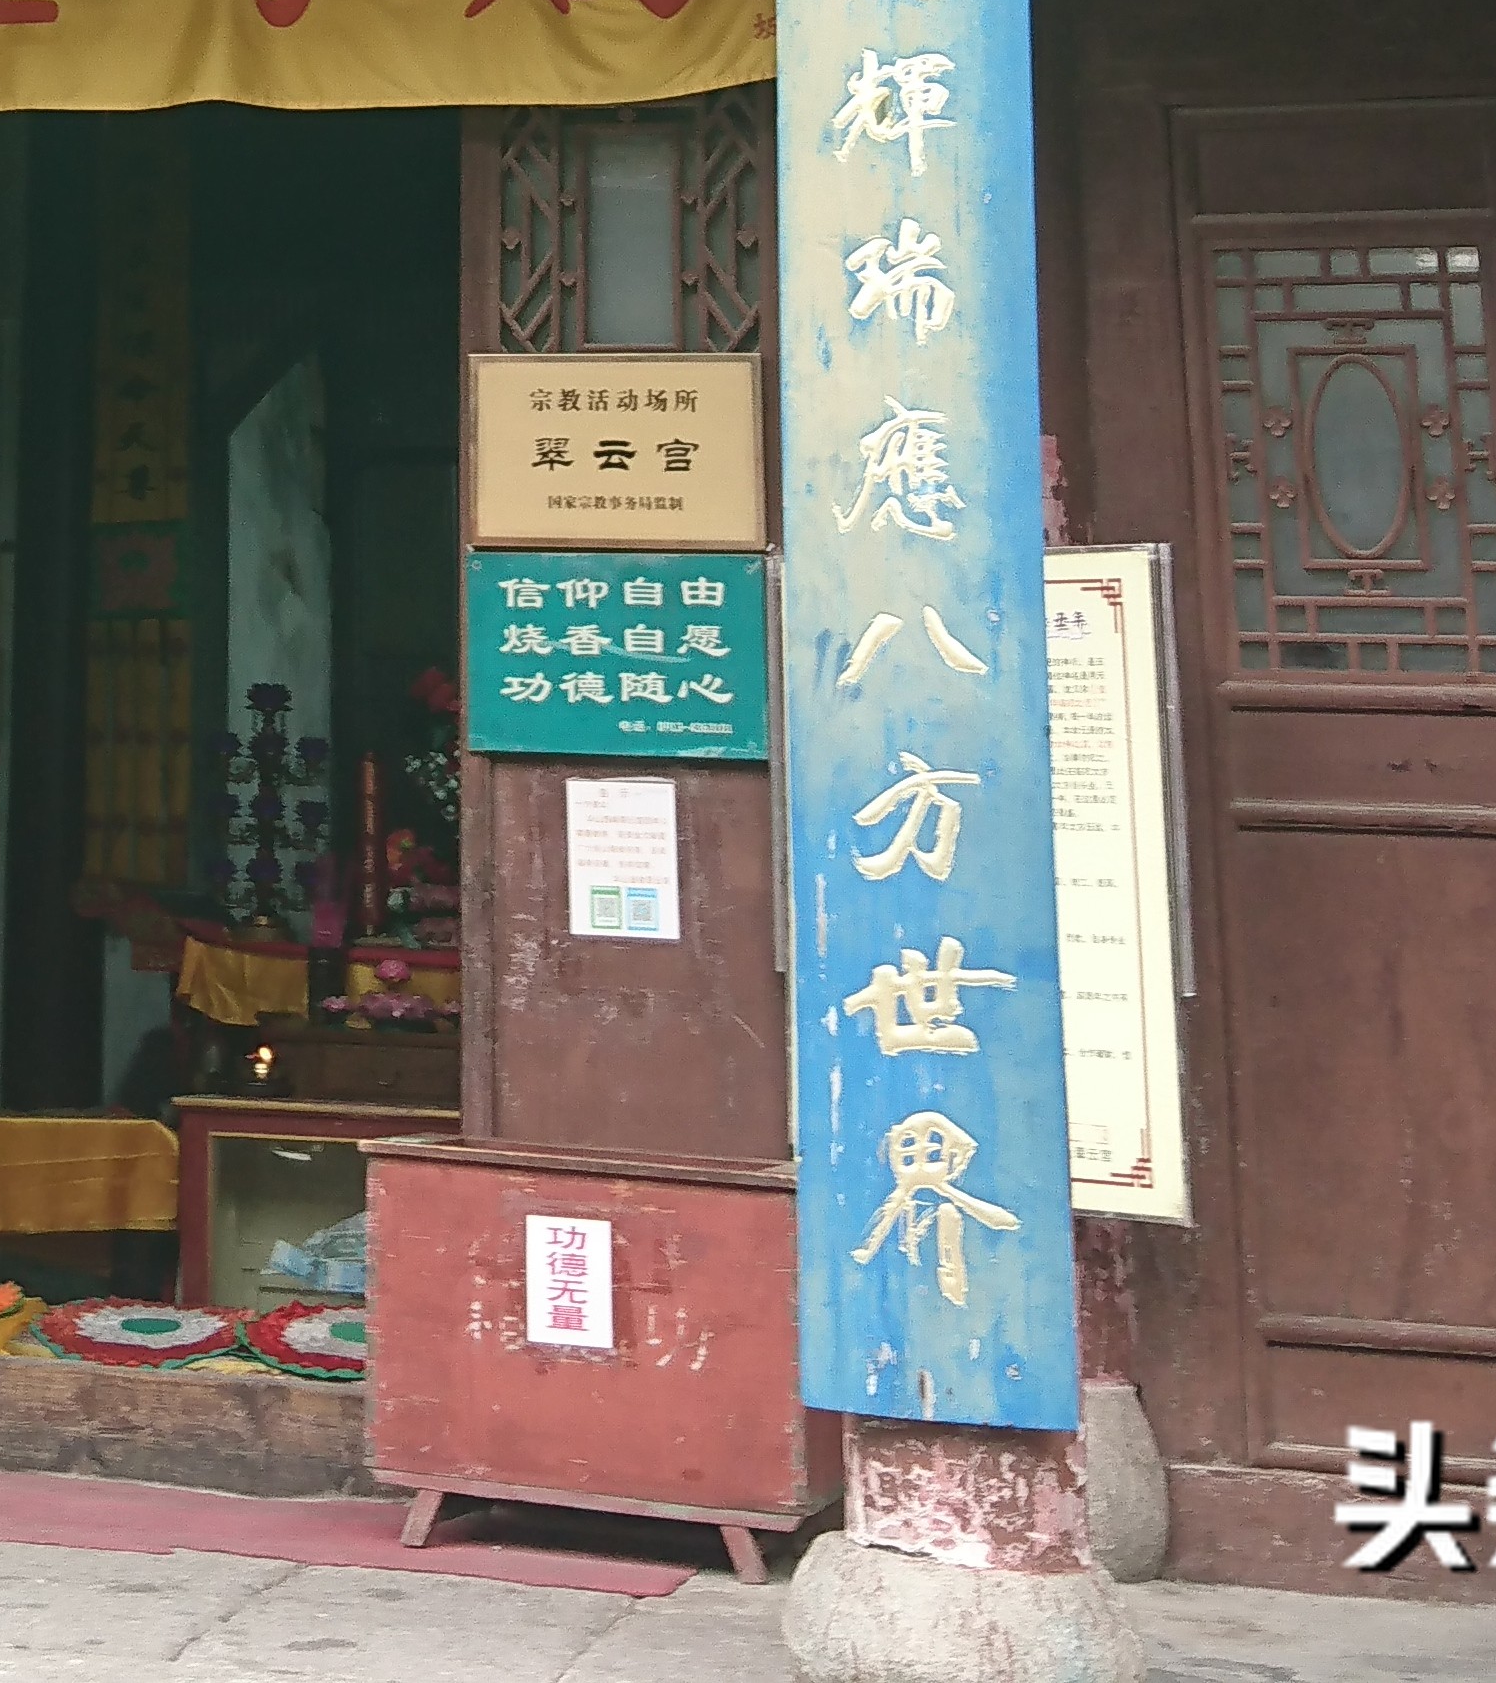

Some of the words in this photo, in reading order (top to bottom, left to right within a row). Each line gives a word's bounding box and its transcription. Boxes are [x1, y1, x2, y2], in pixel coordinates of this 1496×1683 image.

[529, 388, 699, 413] 宗教活动场所
[531, 436, 700, 472] 翠云宫
[498, 576, 726, 609] 信仰自由
[499, 623, 731, 658] 烧香自愿
[500, 672, 734, 705] 功德随心
[545, 1225, 590, 1333] 功德无量
